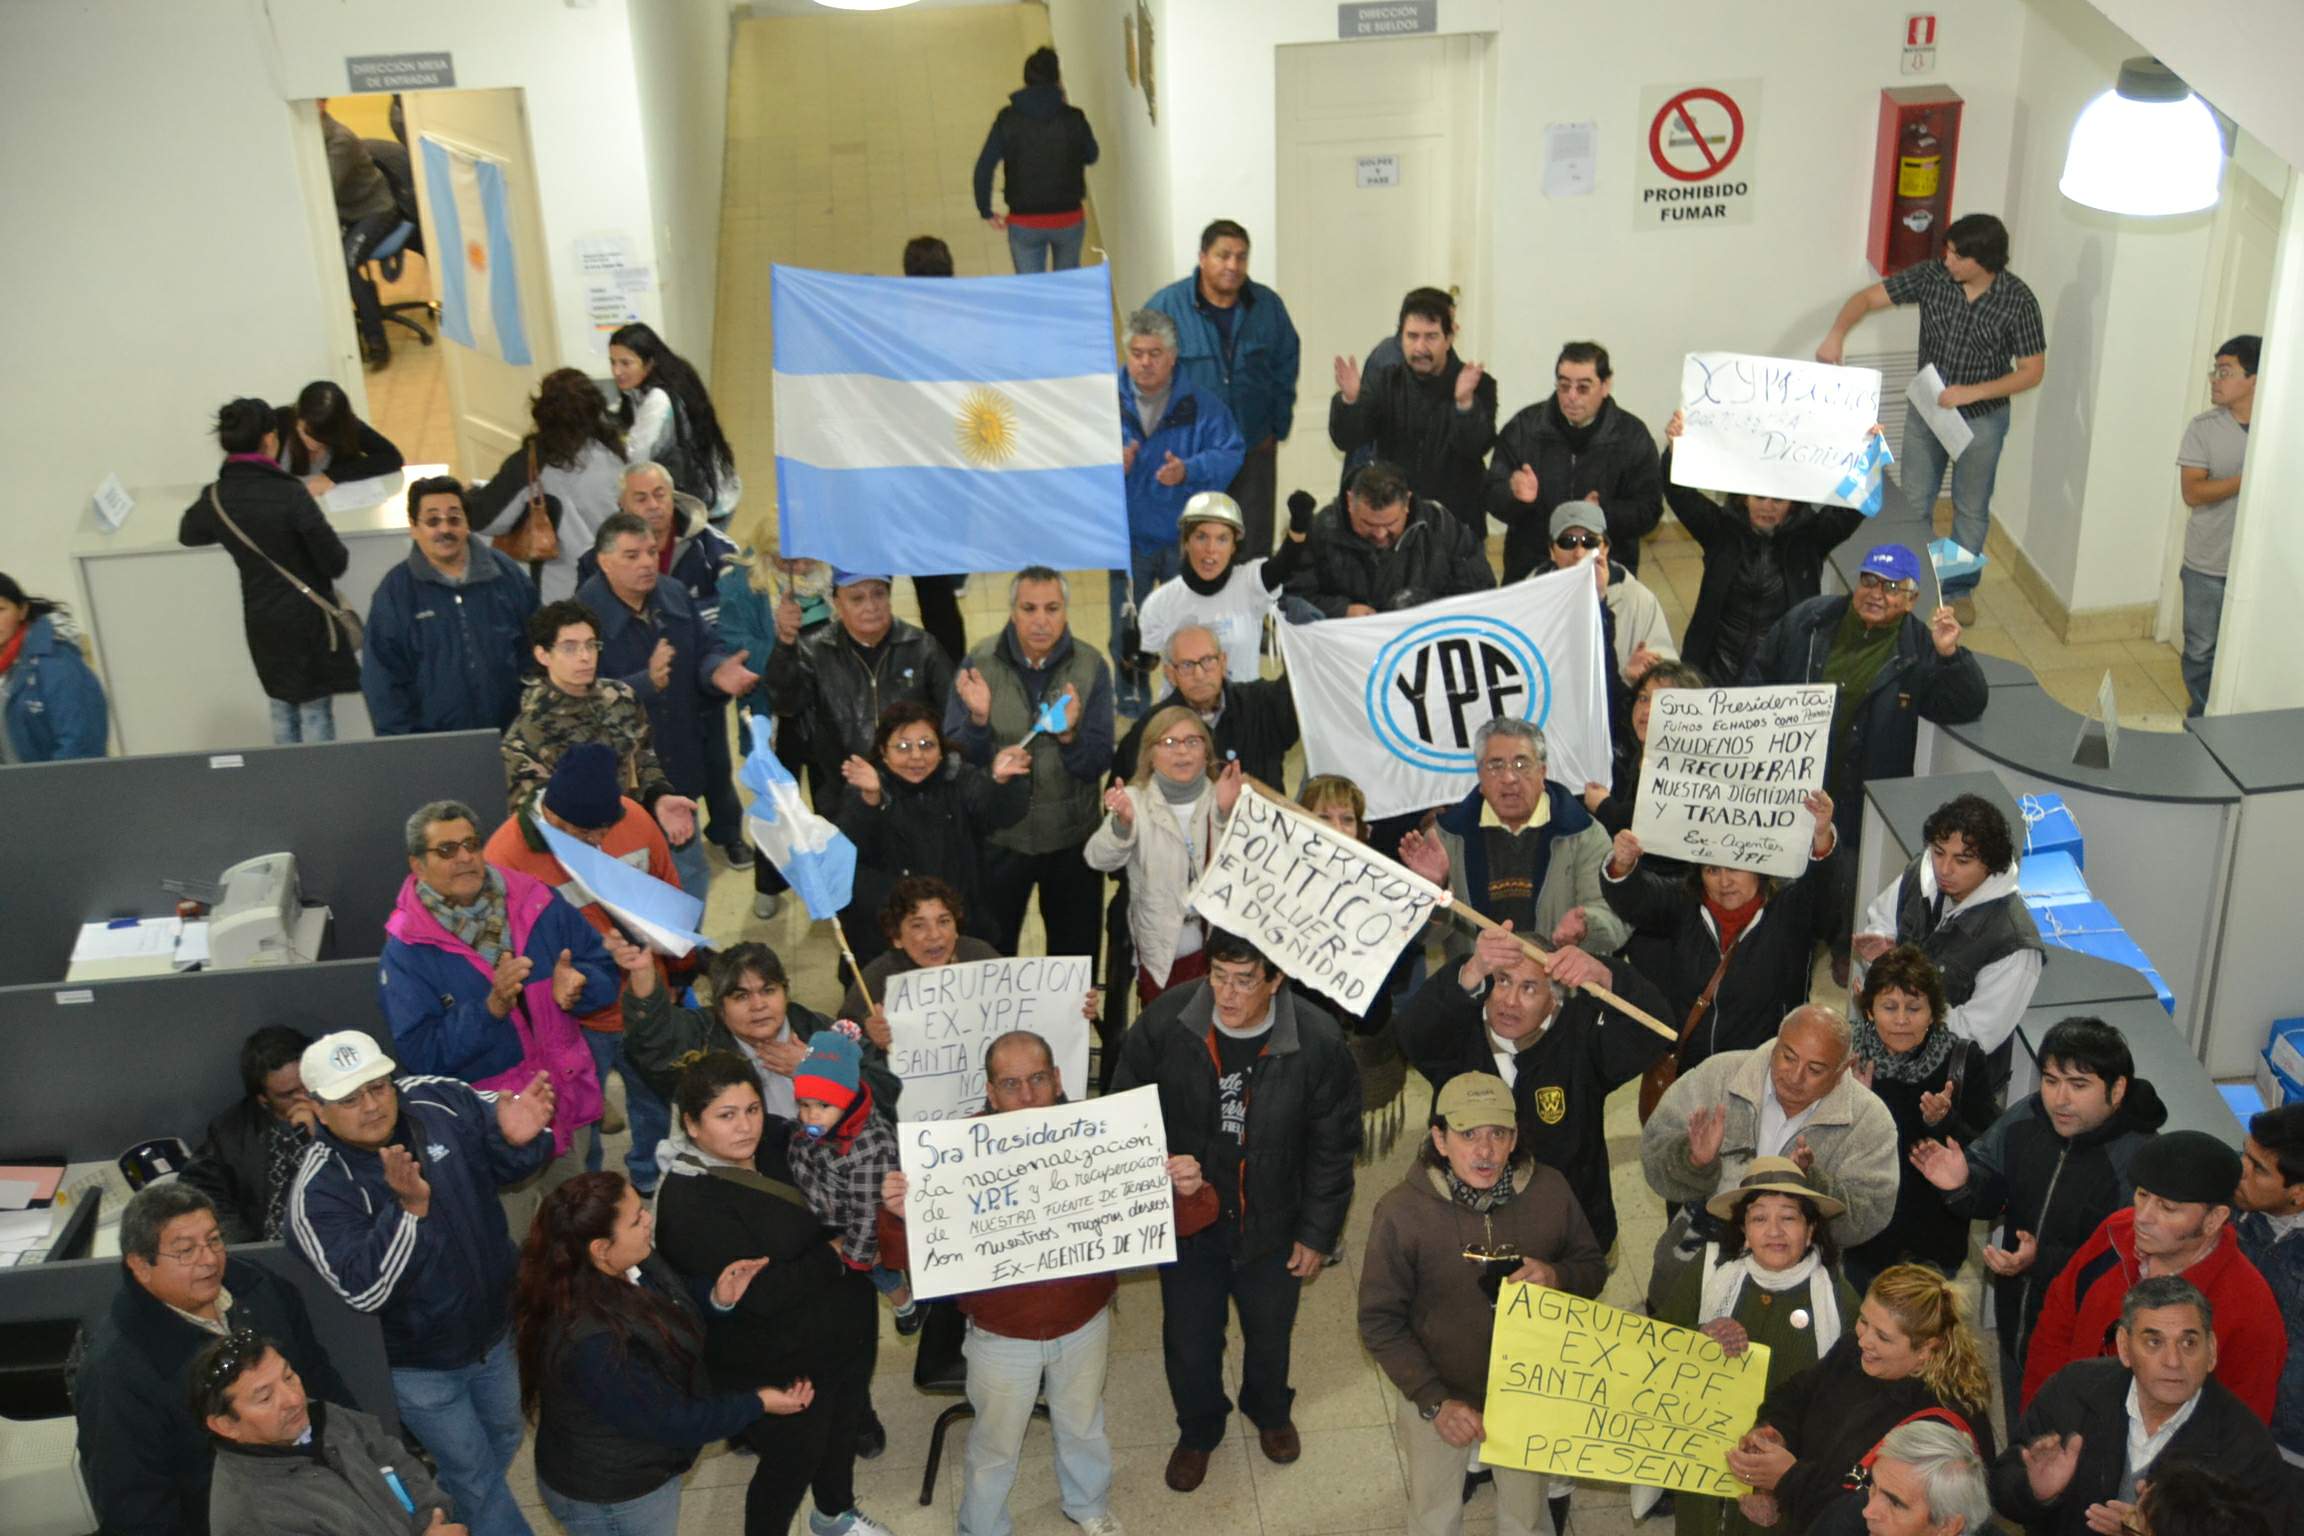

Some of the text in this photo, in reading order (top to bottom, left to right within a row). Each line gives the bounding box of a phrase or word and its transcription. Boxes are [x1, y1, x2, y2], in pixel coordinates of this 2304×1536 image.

[1643, 182, 1748, 203] PROHIBIDO
[1660, 204, 1726, 222] FUMAR
[1396, 638, 1523, 749] YPF
[1660, 694, 1702, 716] Sra
[1656, 730, 1817, 756] AYUDENOS HOY
[1657, 756, 1815, 782] A RECUPERAR
[1651, 777, 1721, 800] NUESTRA
[1655, 801, 1796, 829] Y TRABAJO
[1248, 797, 1437, 924] UN ERROR
[1691, 847, 1774, 865] de YPF
[1241, 901, 1366, 1001] DIGNIDAD
[334, 1046, 358, 1067] YPF
[896, 1043, 968, 1075] SANTA
[918, 1118, 1108, 1169] Sra Presidenta:
[914, 1174, 953, 1203] La
[922, 1203, 950, 1223] de
[1028, 1184, 1040, 1204] y
[1050, 1171, 1070, 1192] la
[926, 1175, 1169, 1245] de NUESTRA FUENTE DE TRABAJO
[1128, 1197, 1170, 1219] deseos
[1112, 1234, 1132, 1256] DE
[1138, 1221, 1170, 1254] YPF
[1631, 1388, 1734, 1436] CRUZ
[1524, 1434, 1736, 1493] PRESENTE
